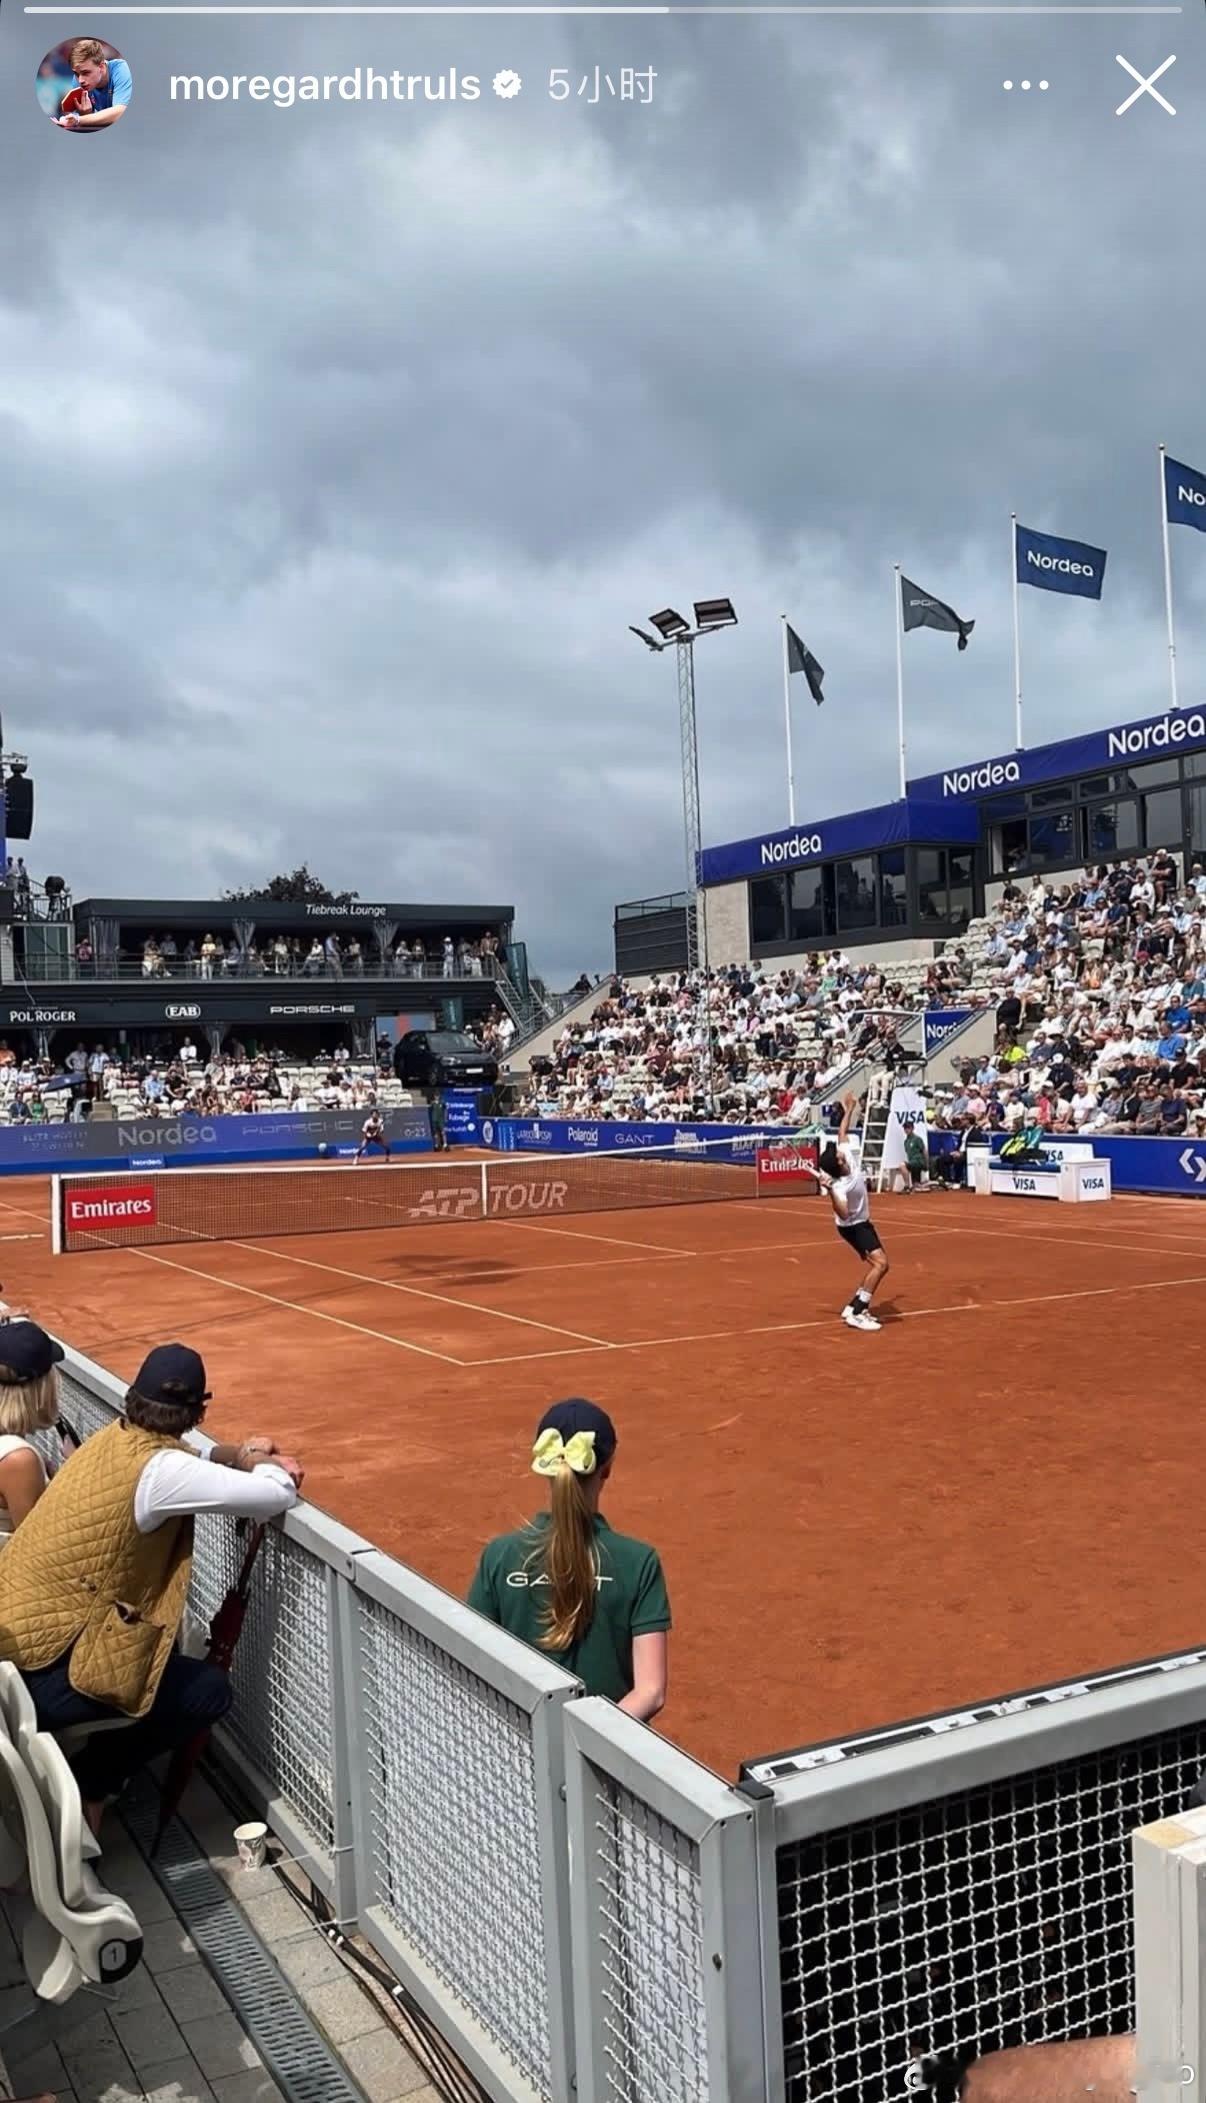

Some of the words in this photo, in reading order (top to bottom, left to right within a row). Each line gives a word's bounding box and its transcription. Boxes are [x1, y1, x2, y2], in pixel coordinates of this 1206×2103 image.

[1027, 550, 1094, 577] Nordea
[1108, 712, 1206, 758] Nordea
[942, 758, 1021, 797] Nordea
[761, 833, 822, 865] Nordea
[305, 904, 348, 916] Tiebreak
[350, 905, 386, 918] Lounge
[9, 1010, 34, 1022] POL
[35, 1010, 76, 1022] ROGER
[170, 1005, 197, 1017] EAB
[270, 1005, 355, 1013] PORSCHE
[896, 1110, 926, 1124] VISA
[118, 1123, 217, 1146] Nordea
[242, 1120, 353, 1135] PORSCHE
[568, 1126, 598, 1142] Polaroid
[615, 1133, 655, 1145] GANT
[1013, 1177, 1036, 1191] VISA
[1082, 1177, 1104, 1190] VISA
[407, 1186, 480, 1218] ATP
[489, 1181, 568, 1212] TOUR
[71, 1198, 152, 1220] Emirates
[506, 1571, 613, 1592] GAT
